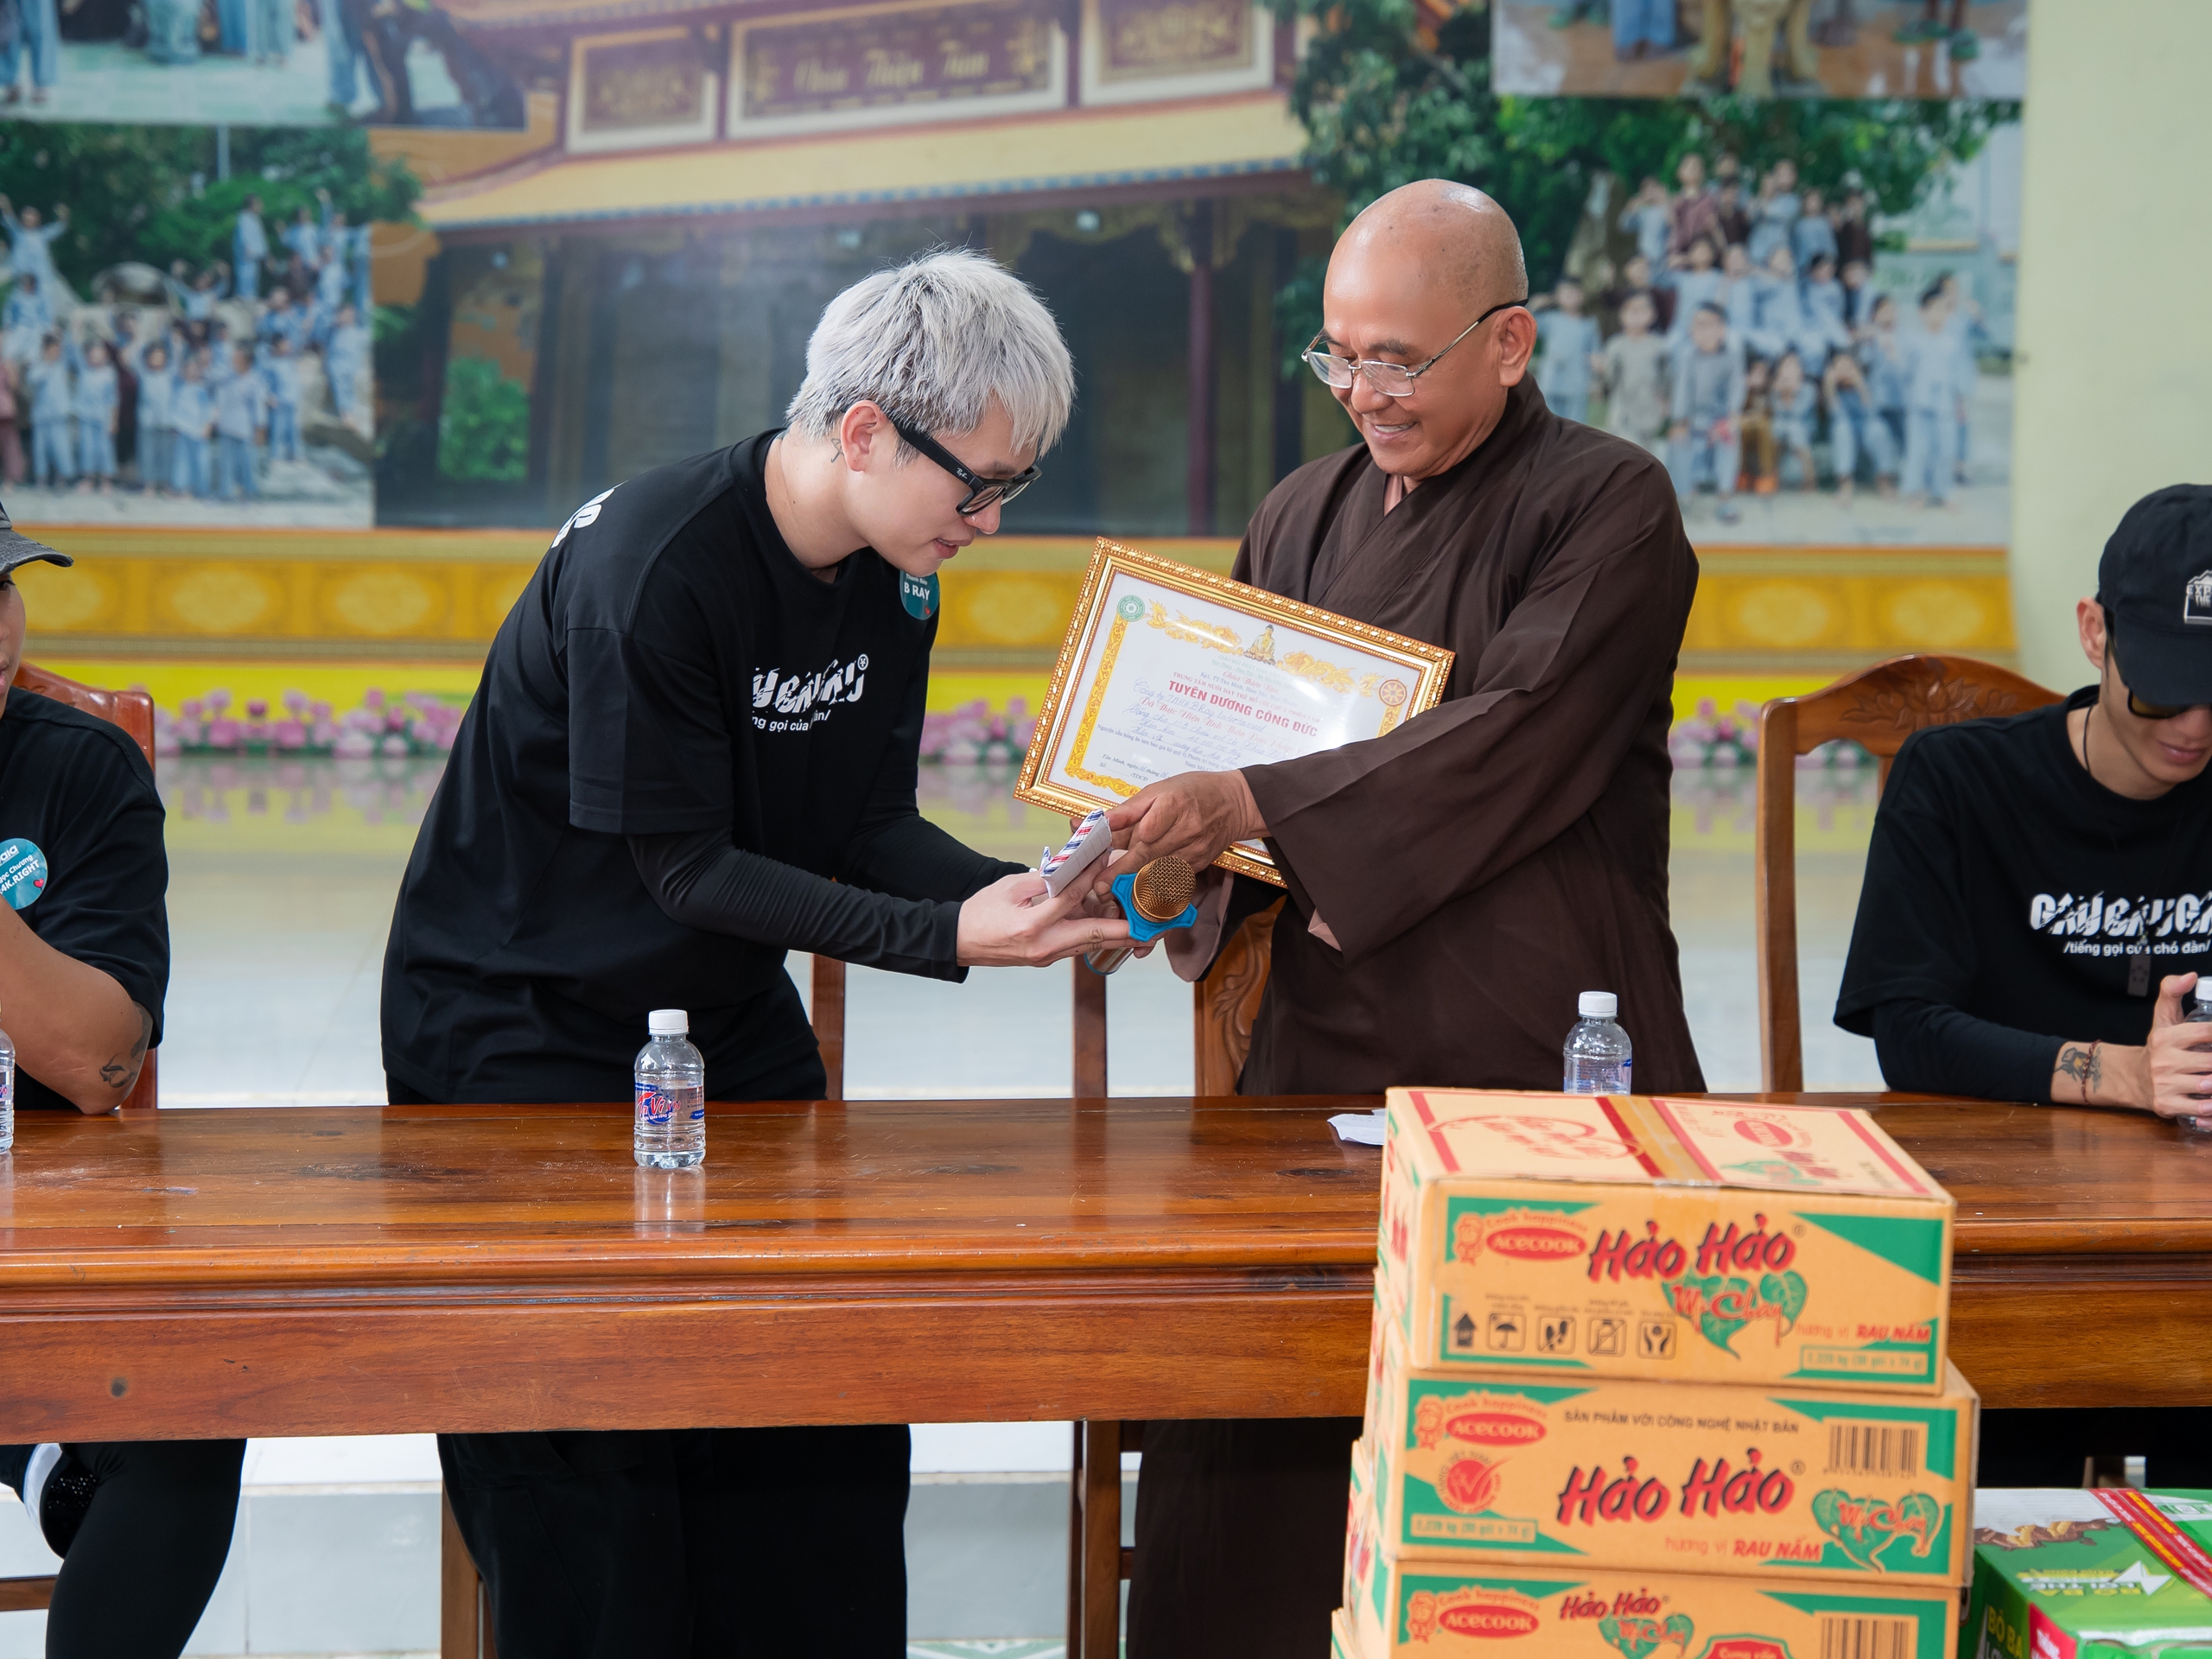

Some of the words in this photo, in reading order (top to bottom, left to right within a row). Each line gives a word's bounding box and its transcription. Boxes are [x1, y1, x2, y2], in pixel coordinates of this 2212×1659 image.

[904, 582, 911, 594] B
[912, 584, 931, 601] RAY
[1173, 671, 1192, 682] TRUNG
[1166, 678, 1208, 701] TUYÊN
[1209, 693, 1253, 715] DƯƠNG
[1255, 707, 1291, 728] CÔNG
[1291, 719, 1319, 737] ĐỨC
[769, 719, 789, 733] gọi
[790, 718, 810, 731] của
[0, 859, 40, 895] 4K.RIGHT
[9, 854, 34, 874] Chương
[2102, 942, 2124, 958] gọi
[2153, 940, 2179, 955] chó
[1586, 1220, 1688, 1284] Hảo
[1695, 1211, 1797, 1275] Hảo
[1711, 1284, 1783, 1348] Chay
[1856, 1323, 1890, 1342] RAU
[1890, 1319, 1932, 1344] NẤM
[1556, 1454, 1672, 1529] Hảo
[1679, 1446, 1796, 1520] Hảo
[1732, 1539, 1772, 1558] RAU
[1774, 1535, 1821, 1562] NẤM
[1558, 1590, 1610, 1621] Hảo
[1611, 1586, 1662, 1618] Hảo
